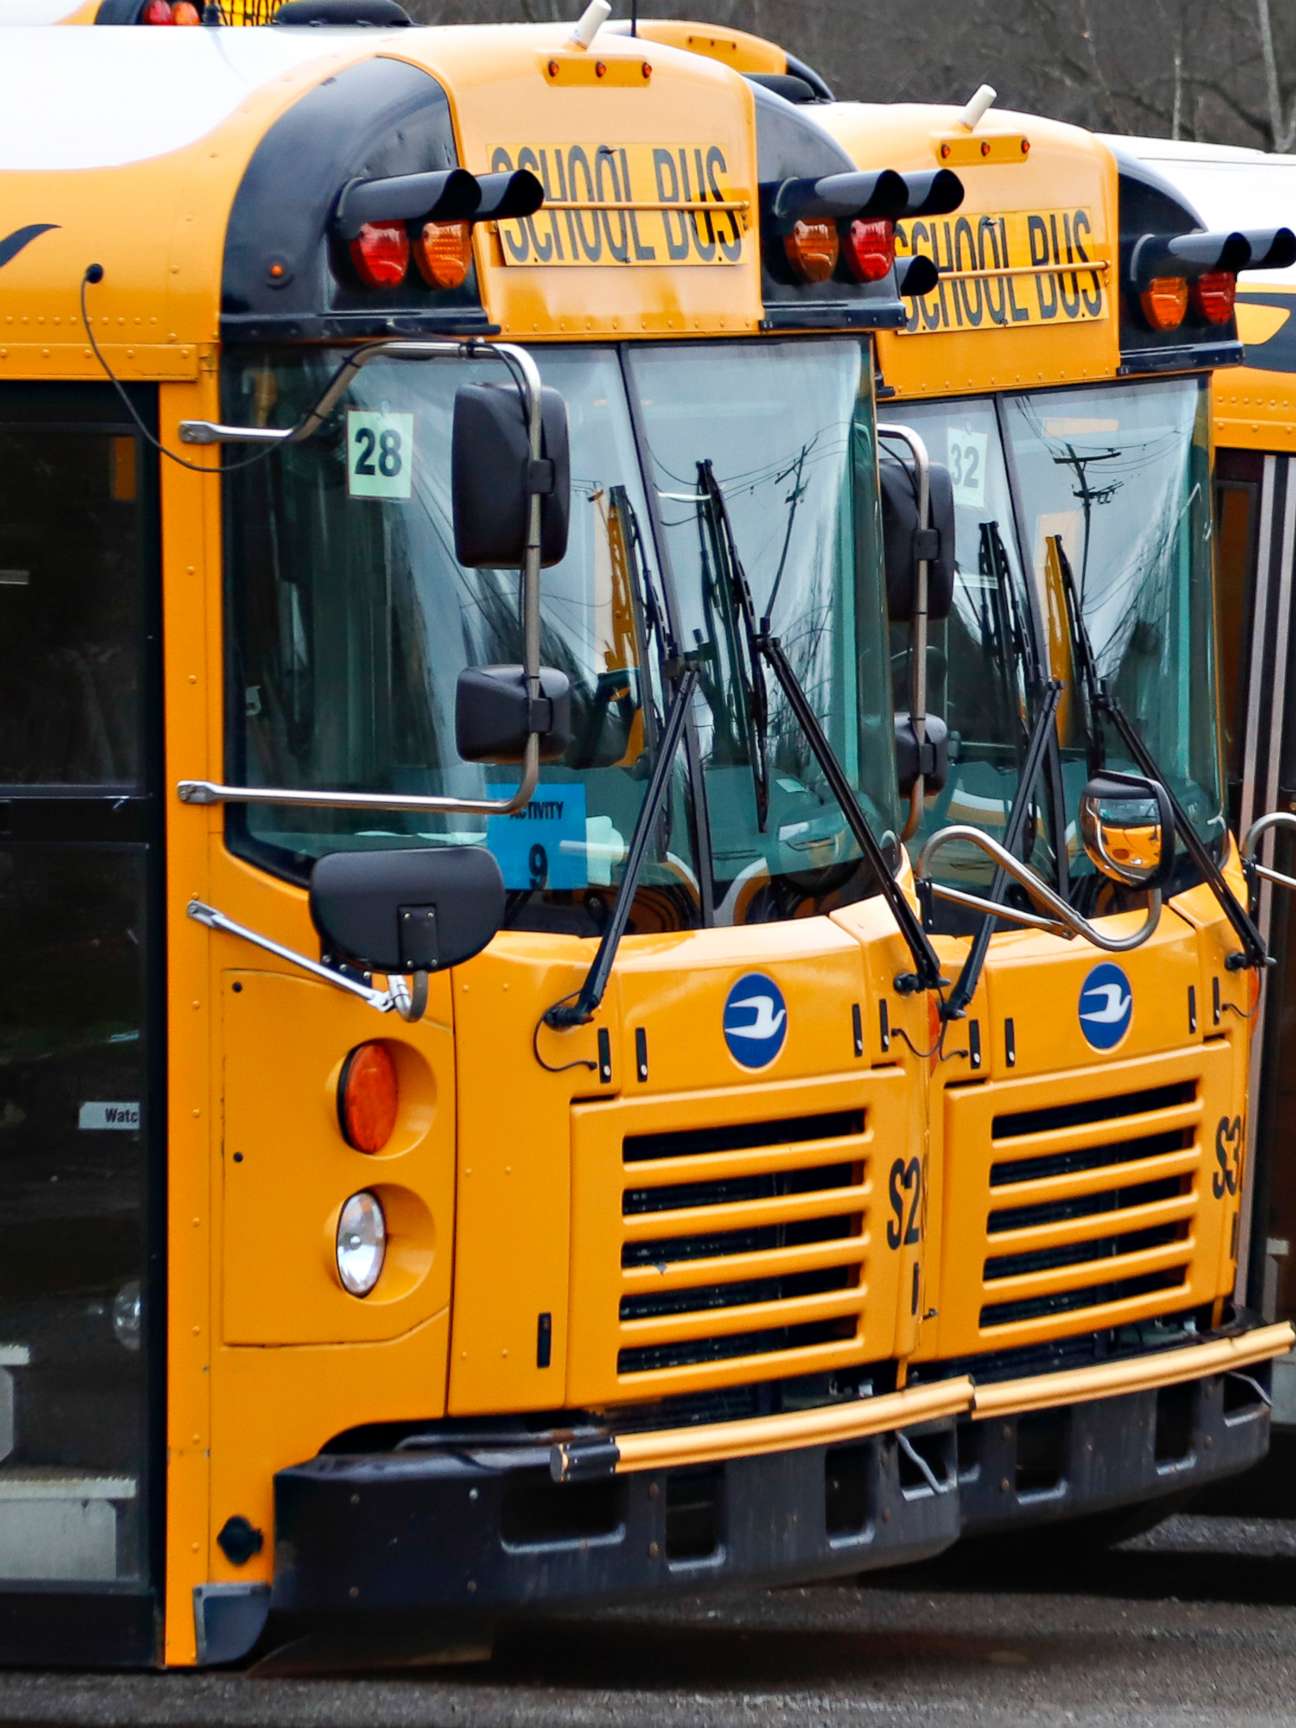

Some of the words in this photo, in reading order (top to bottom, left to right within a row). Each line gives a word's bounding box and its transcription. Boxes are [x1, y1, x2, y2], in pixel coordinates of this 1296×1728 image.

[491, 145, 656, 263] SCHOOL
[652, 145, 742, 262] BUS
[1028, 209, 1102, 319] BUS
[354, 427, 402, 478] 28
[950, 443, 980, 489] 32
[528, 844, 548, 889] 9
